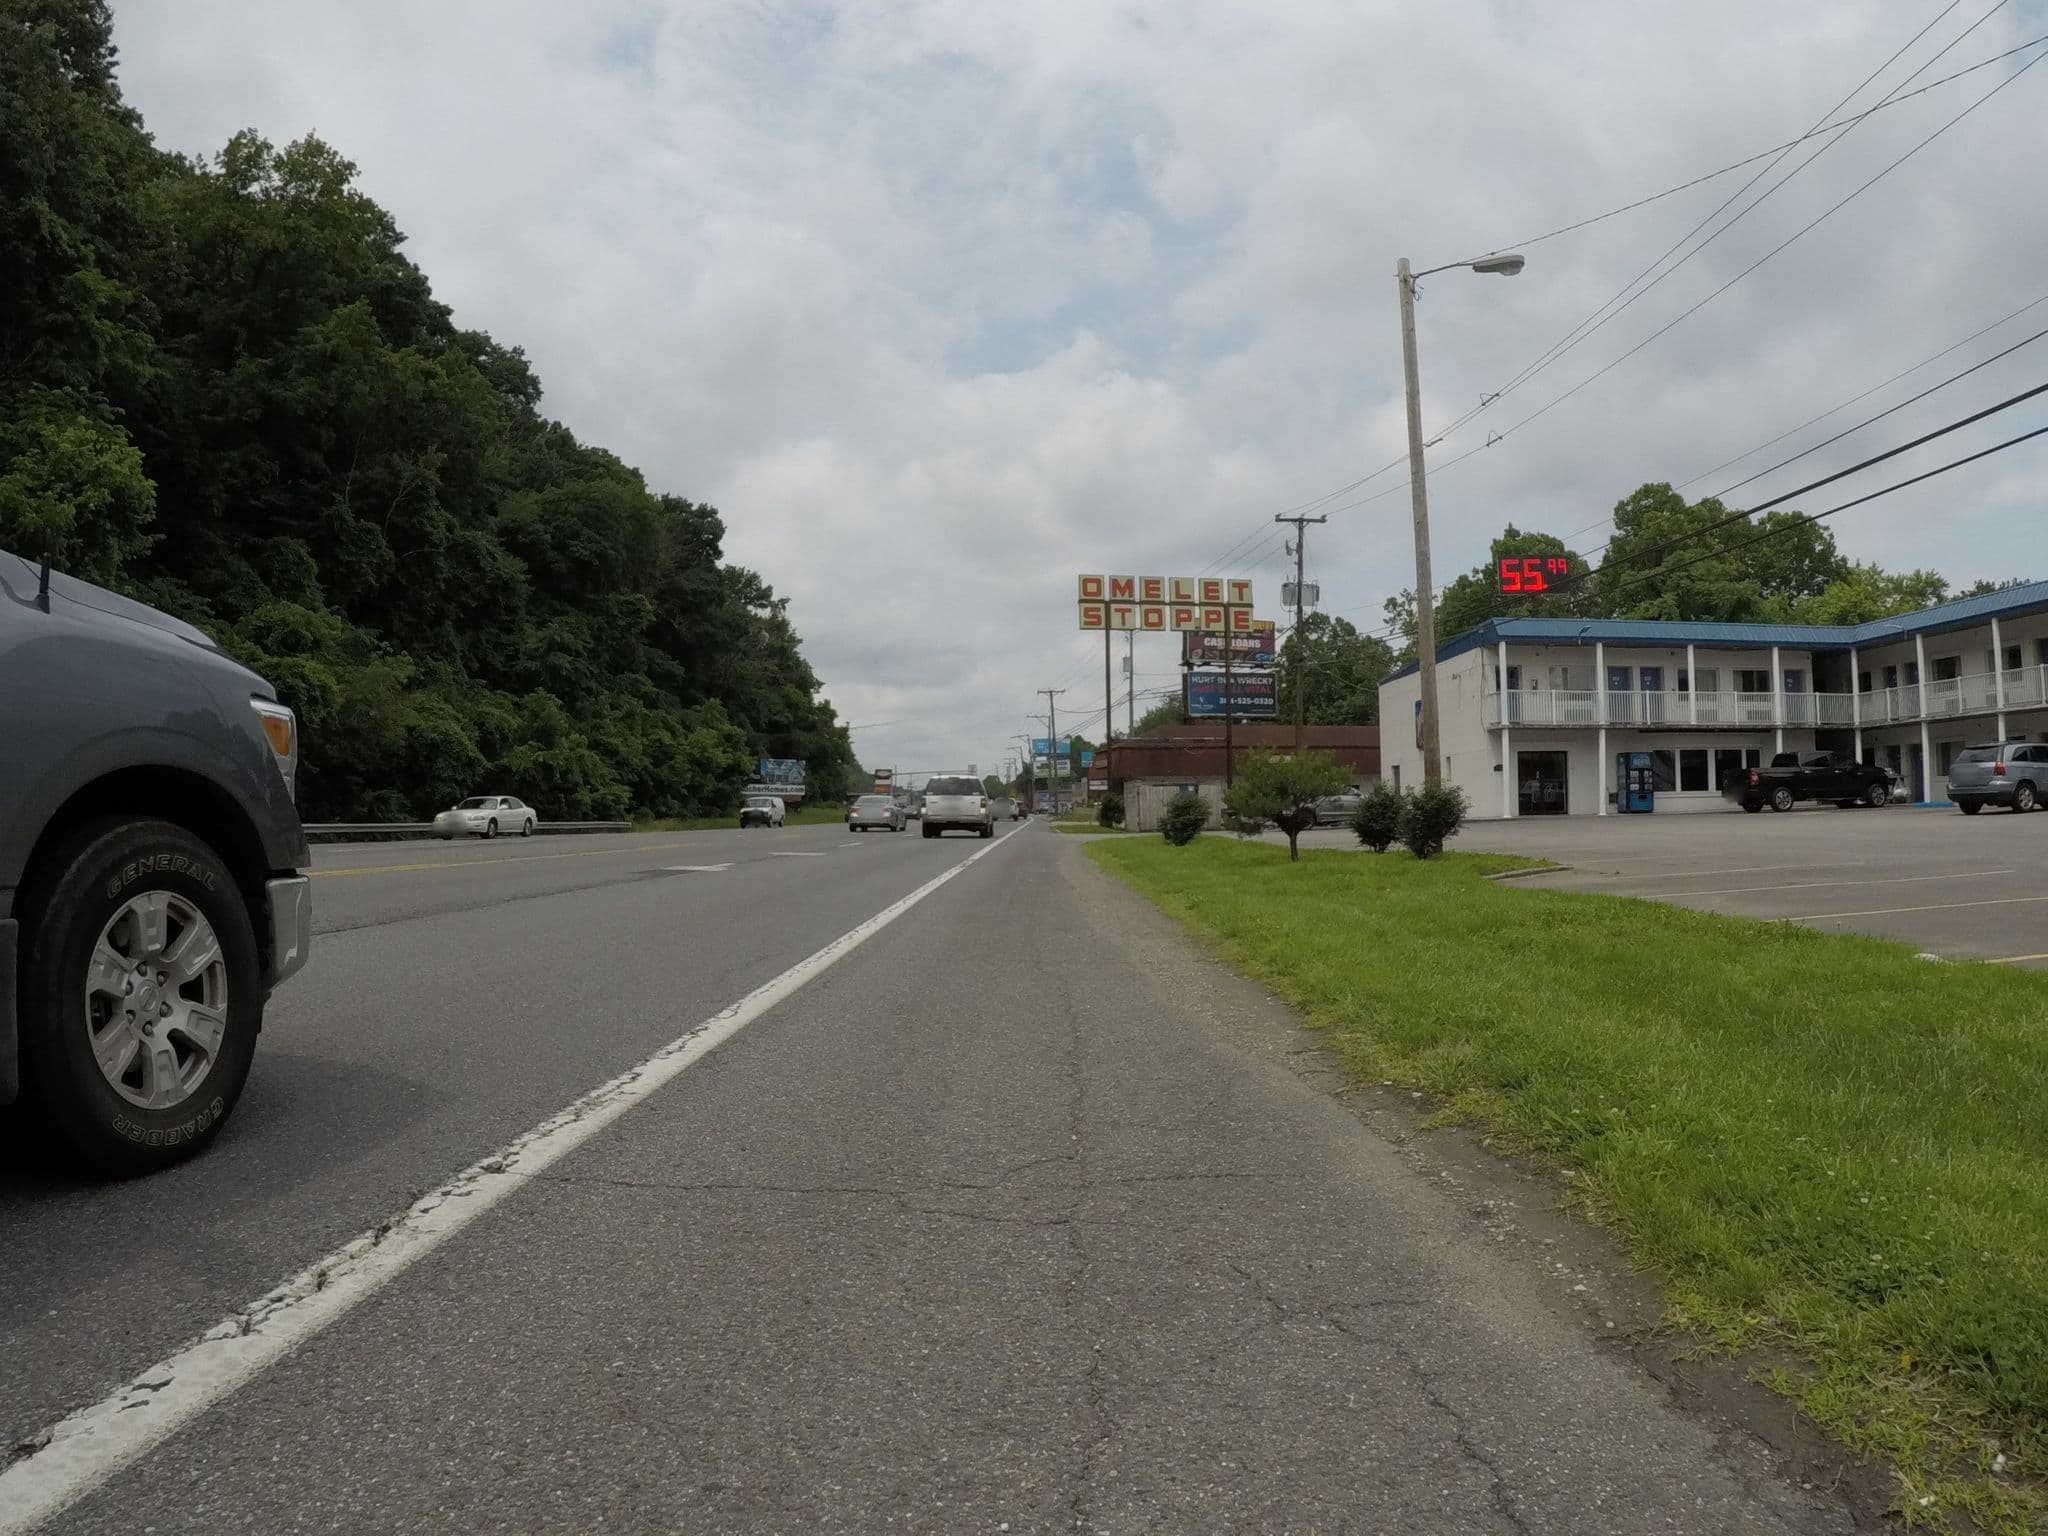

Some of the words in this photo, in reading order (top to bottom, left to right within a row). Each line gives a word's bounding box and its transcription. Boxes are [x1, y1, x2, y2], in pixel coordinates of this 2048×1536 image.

[1082, 578, 1249, 601] OMELET
[1083, 607, 1250, 630] STOPPE
[1231, 638, 1261, 648] LOANS
[1191, 676, 1216, 684] HURT
[1237, 677, 1273, 685] WRECK?
[107, 854, 216, 899] GENERAL
[112, 1096, 224, 1146] GRABBER
